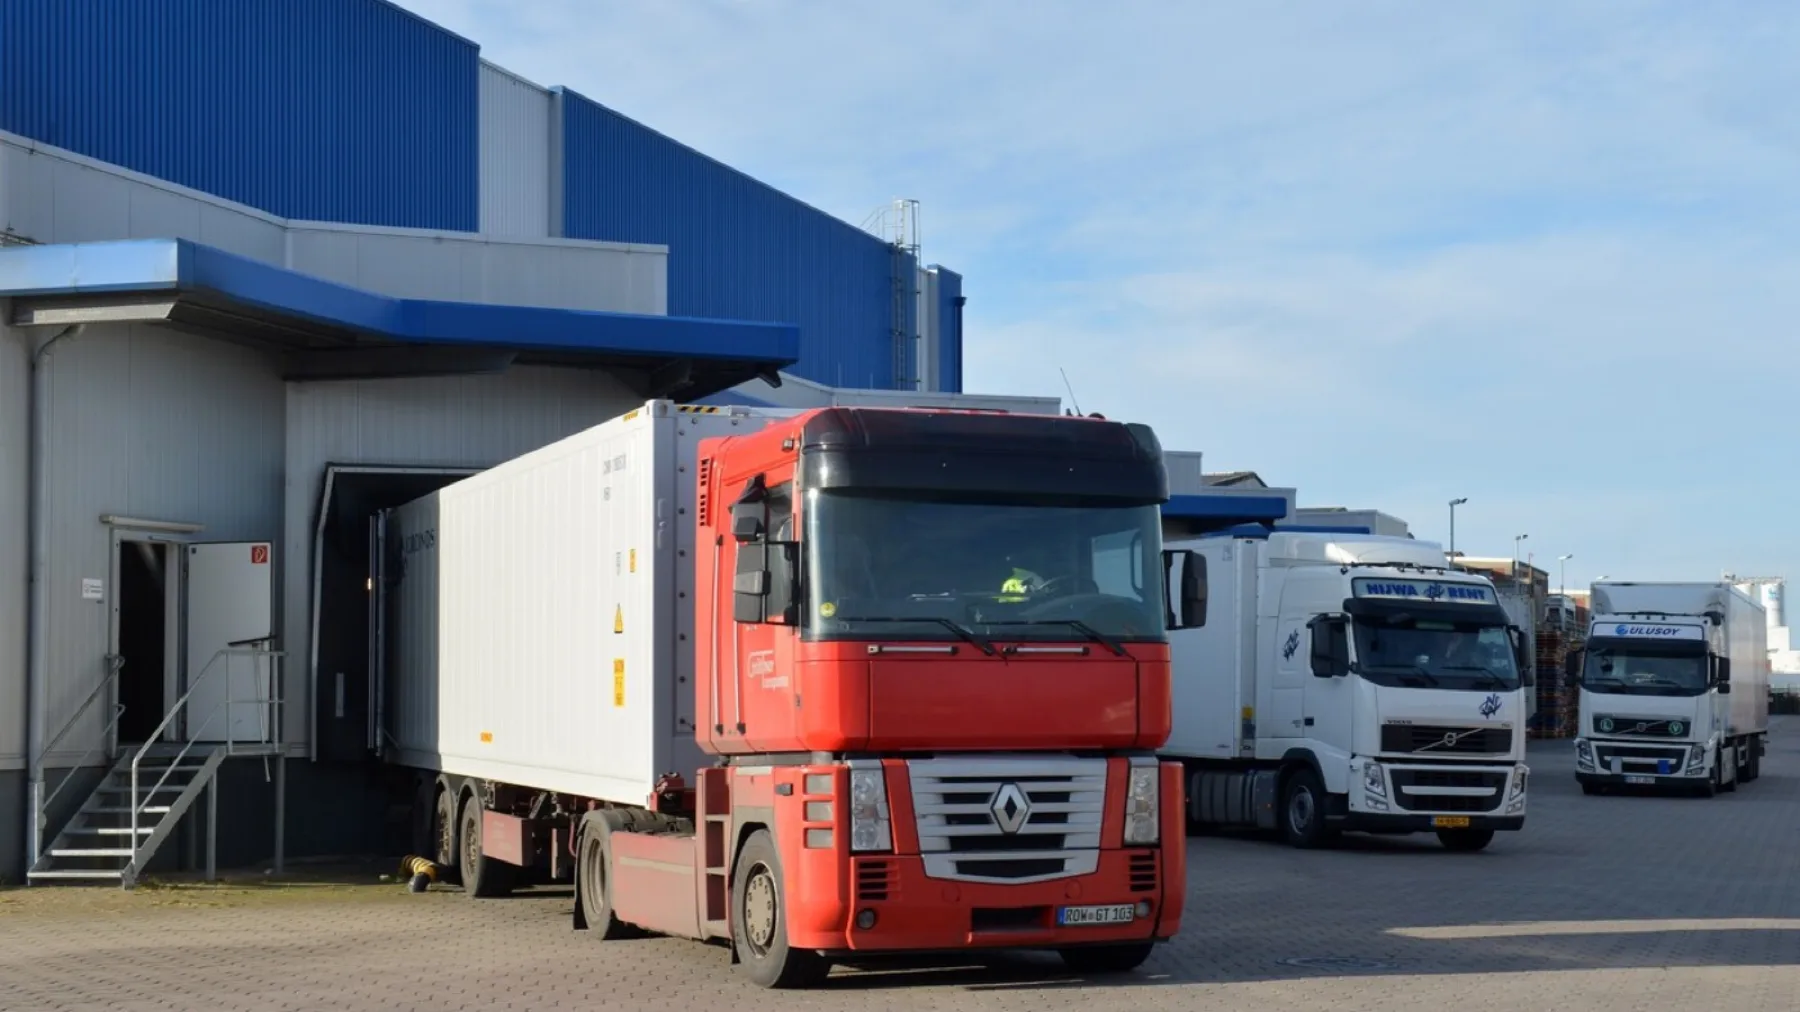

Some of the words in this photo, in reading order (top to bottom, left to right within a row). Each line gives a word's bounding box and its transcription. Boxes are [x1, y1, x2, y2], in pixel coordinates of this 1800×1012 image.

[1366, 583, 1418, 596] NIJWA
[1447, 587, 1485, 600] RENT
[1629, 626, 1680, 636] ULUSOY
[1066, 908, 1088, 922] ROW
[1096, 907, 1111, 921] GT
[1112, 907, 1133, 921] 103
